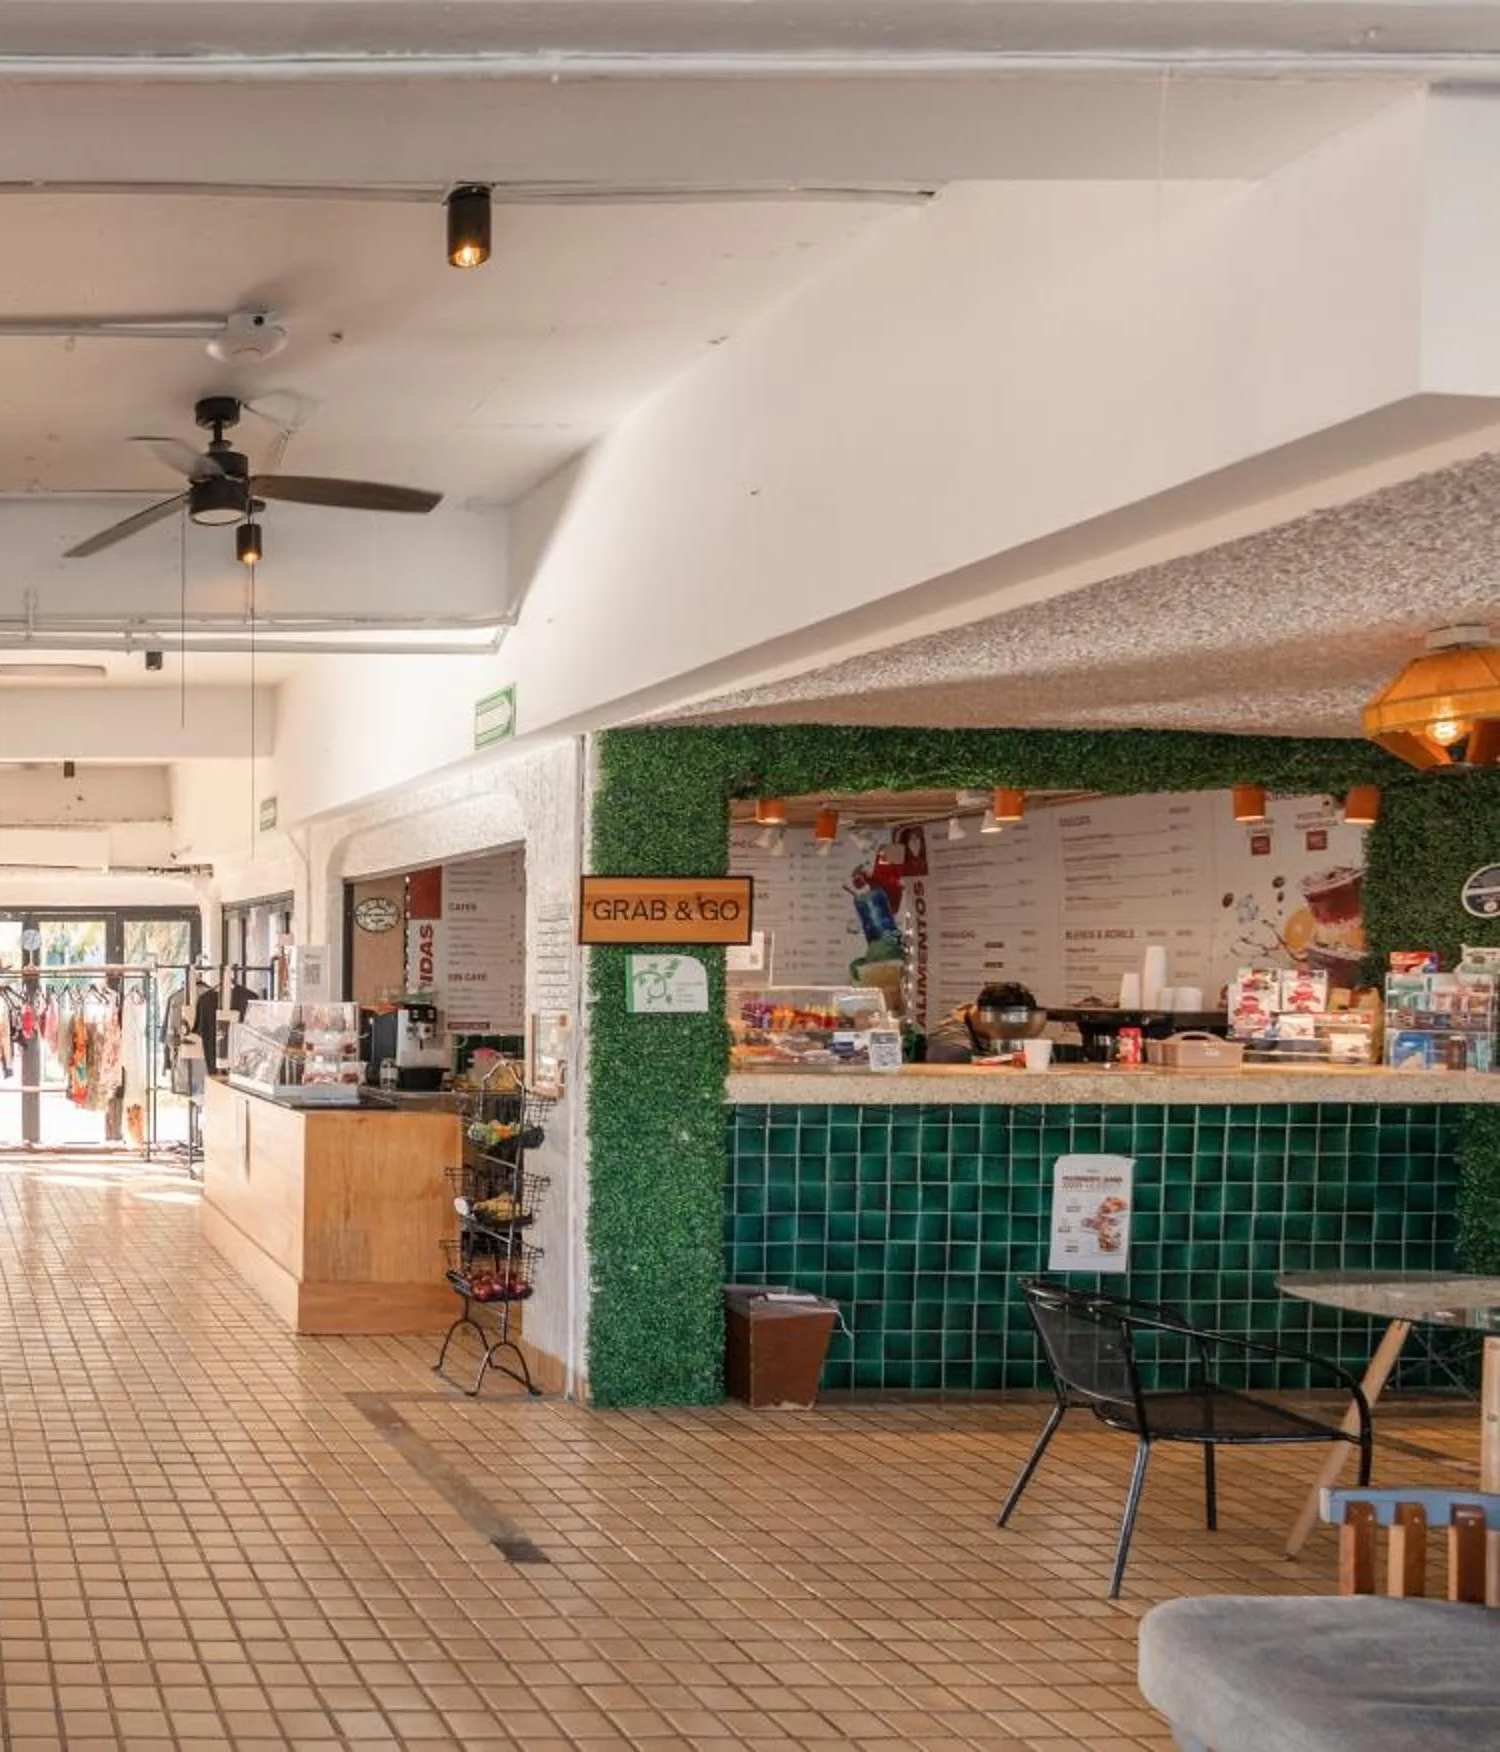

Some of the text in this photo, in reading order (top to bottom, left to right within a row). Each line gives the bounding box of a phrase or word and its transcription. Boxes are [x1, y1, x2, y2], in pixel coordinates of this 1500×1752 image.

[592, 899, 740, 921] GRAB & GO
[913, 881, 928, 1028] ALIMENTOS
